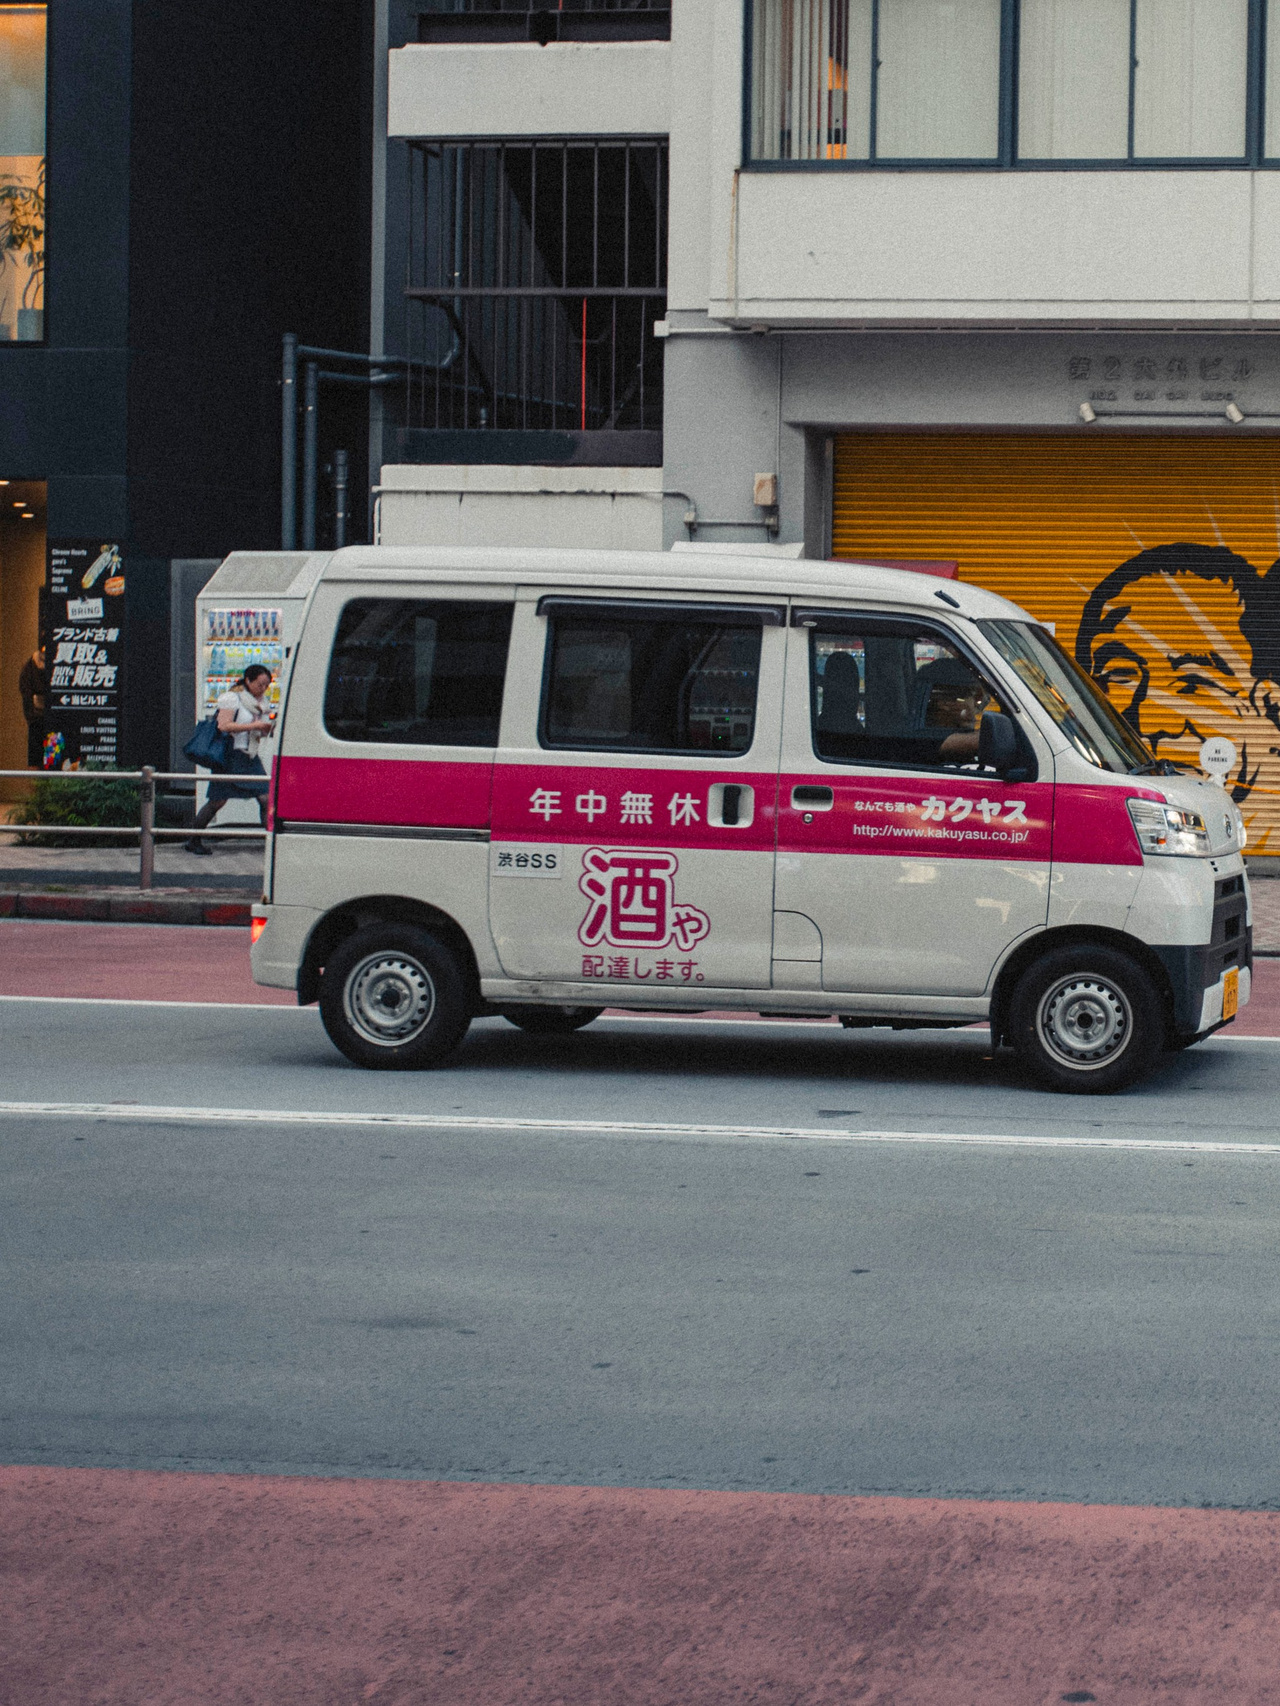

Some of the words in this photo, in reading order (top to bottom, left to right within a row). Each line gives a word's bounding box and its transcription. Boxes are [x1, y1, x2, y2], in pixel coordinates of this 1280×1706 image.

[72, 606, 100, 616] BRING
[53, 627, 119, 642] ブランド古着
[71, 664, 118, 688] 販売
[529, 788, 701, 826] 年中無休
[854, 800, 916, 813] なんでも酒や
[920, 796, 1028, 824] カクヤス
[853, 824, 1029, 844] http://www.kakuyasu.co.jp/
[498, 852, 557, 869] 渋谷SS
[582, 850, 707, 946] 酒や
[582, 955, 705, 981] 配達します。
